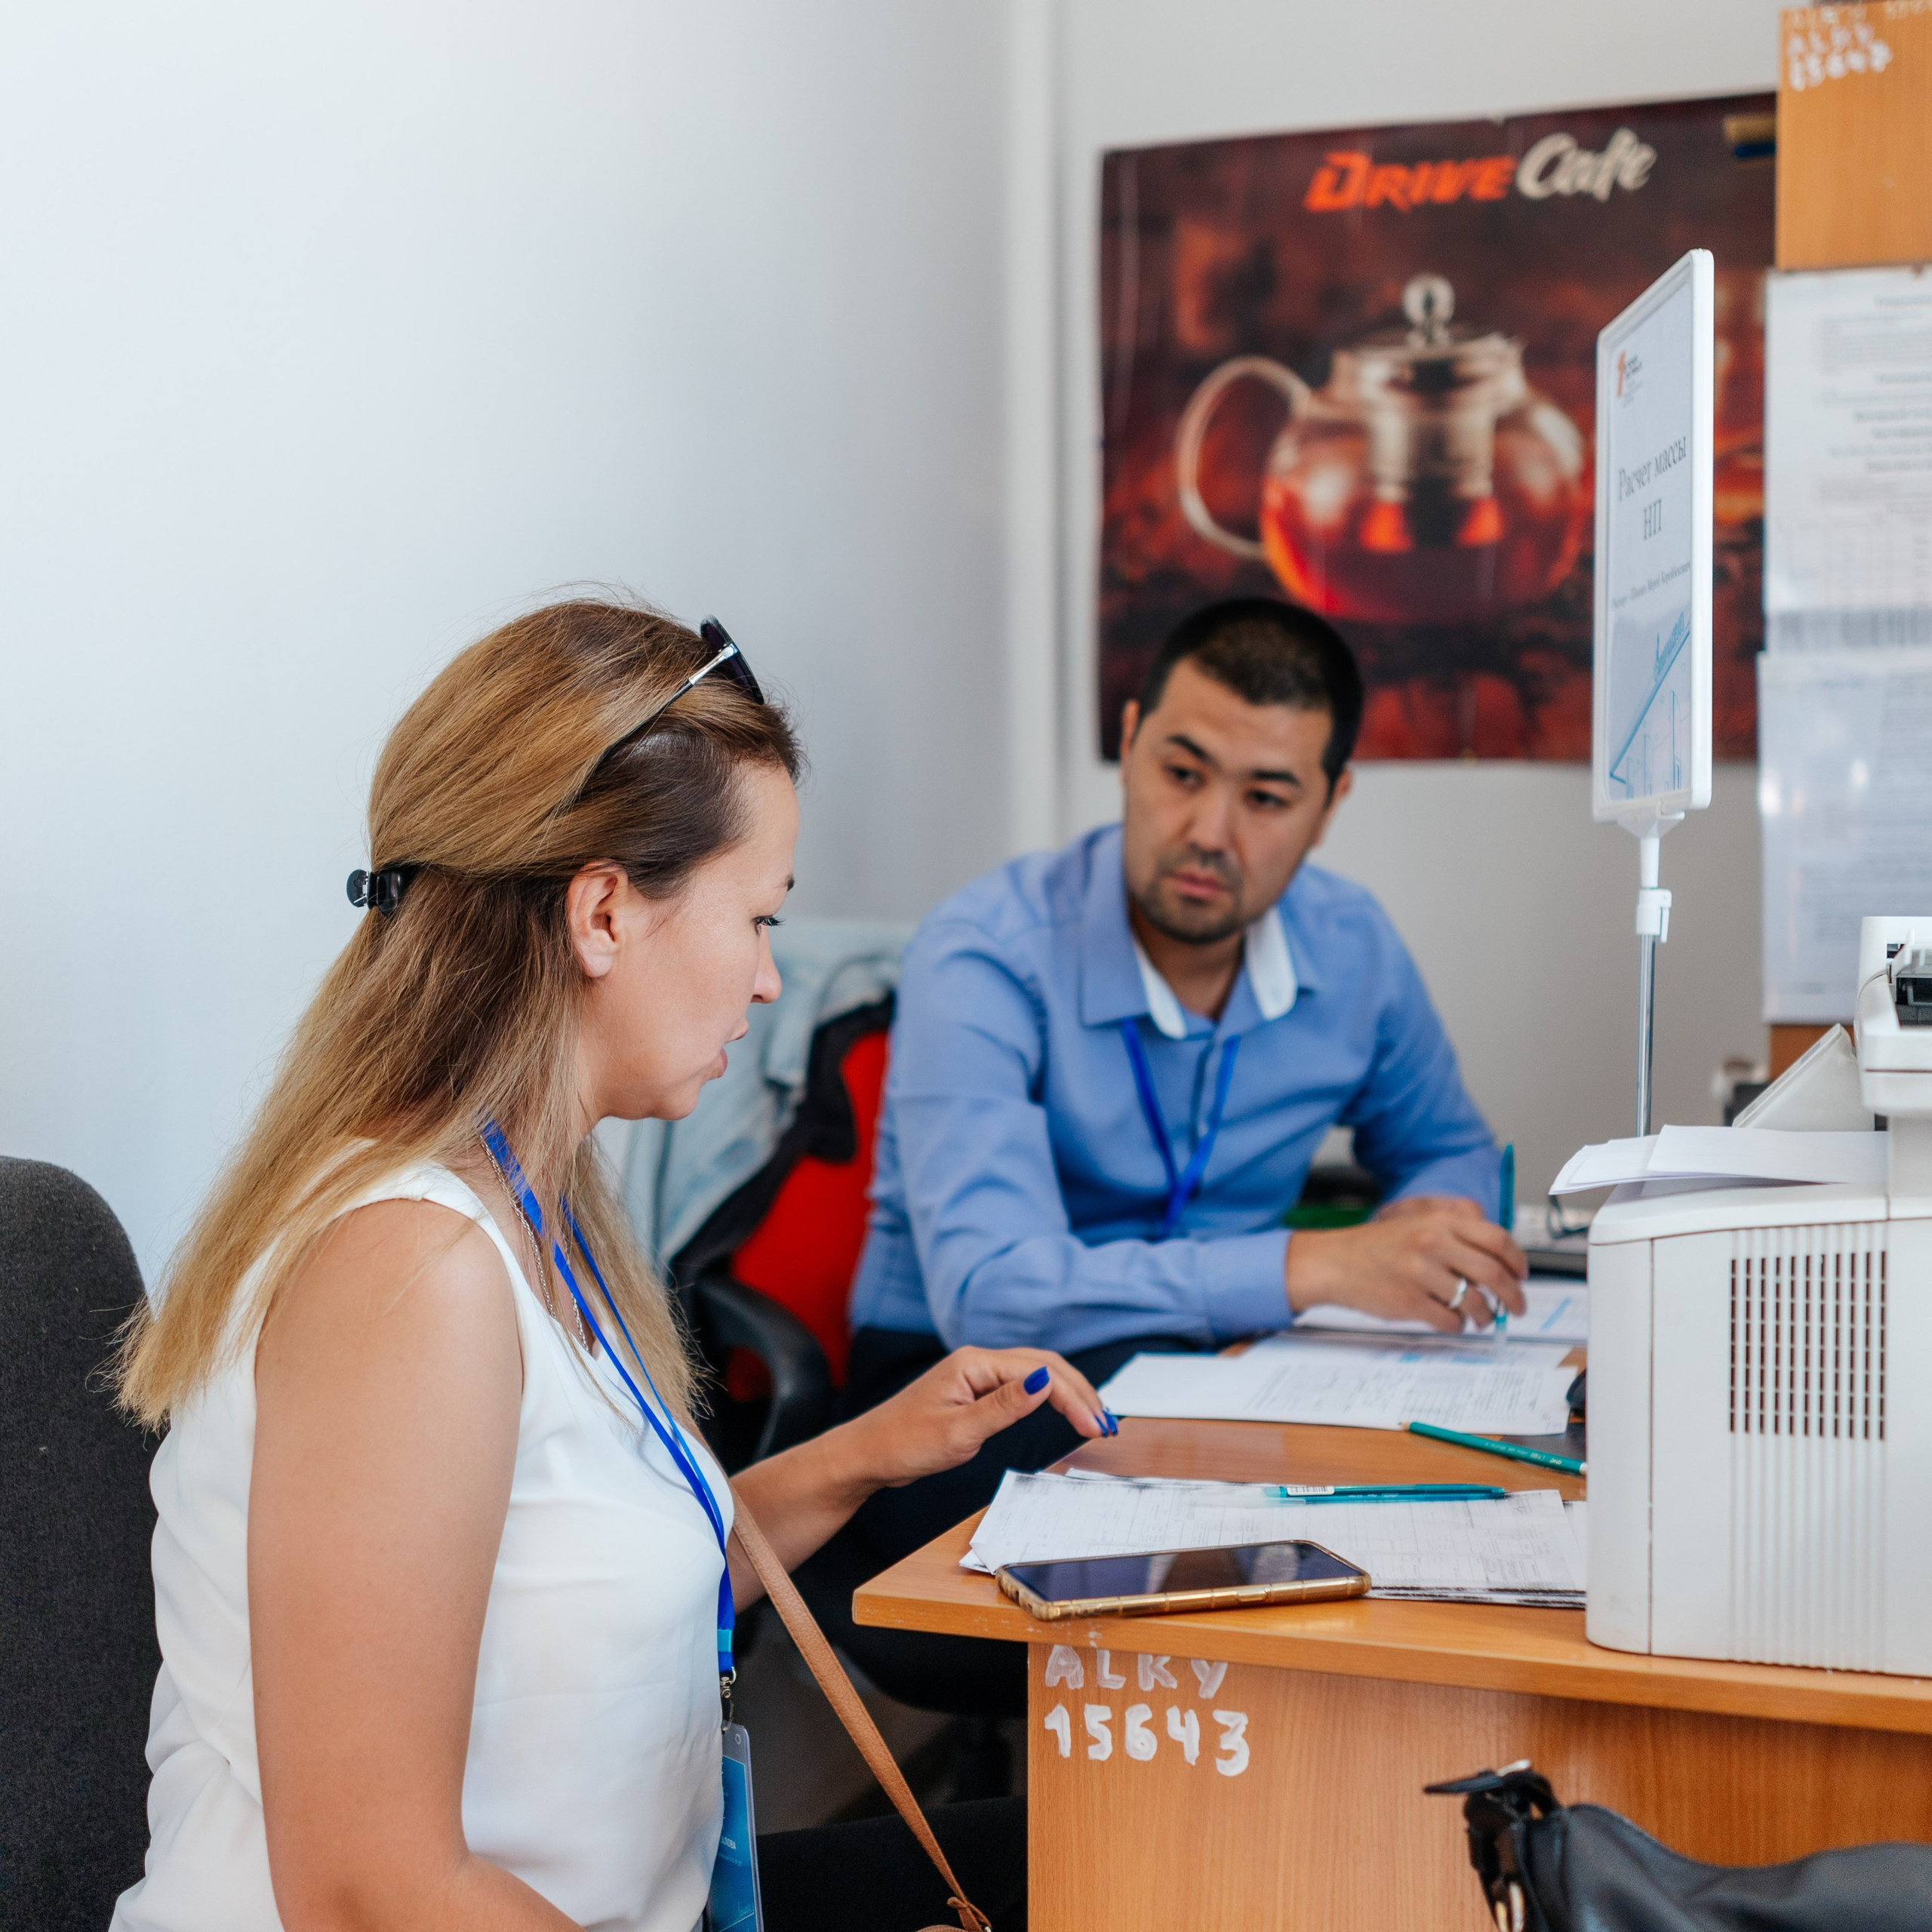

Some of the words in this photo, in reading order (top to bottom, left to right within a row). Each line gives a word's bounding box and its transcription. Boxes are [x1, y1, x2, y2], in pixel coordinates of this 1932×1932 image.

[1303, 149, 1517, 213] DRIVE
[1515, 127, 1657, 202] Cafe
[1654, 435, 1687, 485] массы
[1045, 1644, 1229, 1700] ALKY
[1044, 1703, 1251, 1777] 15643
